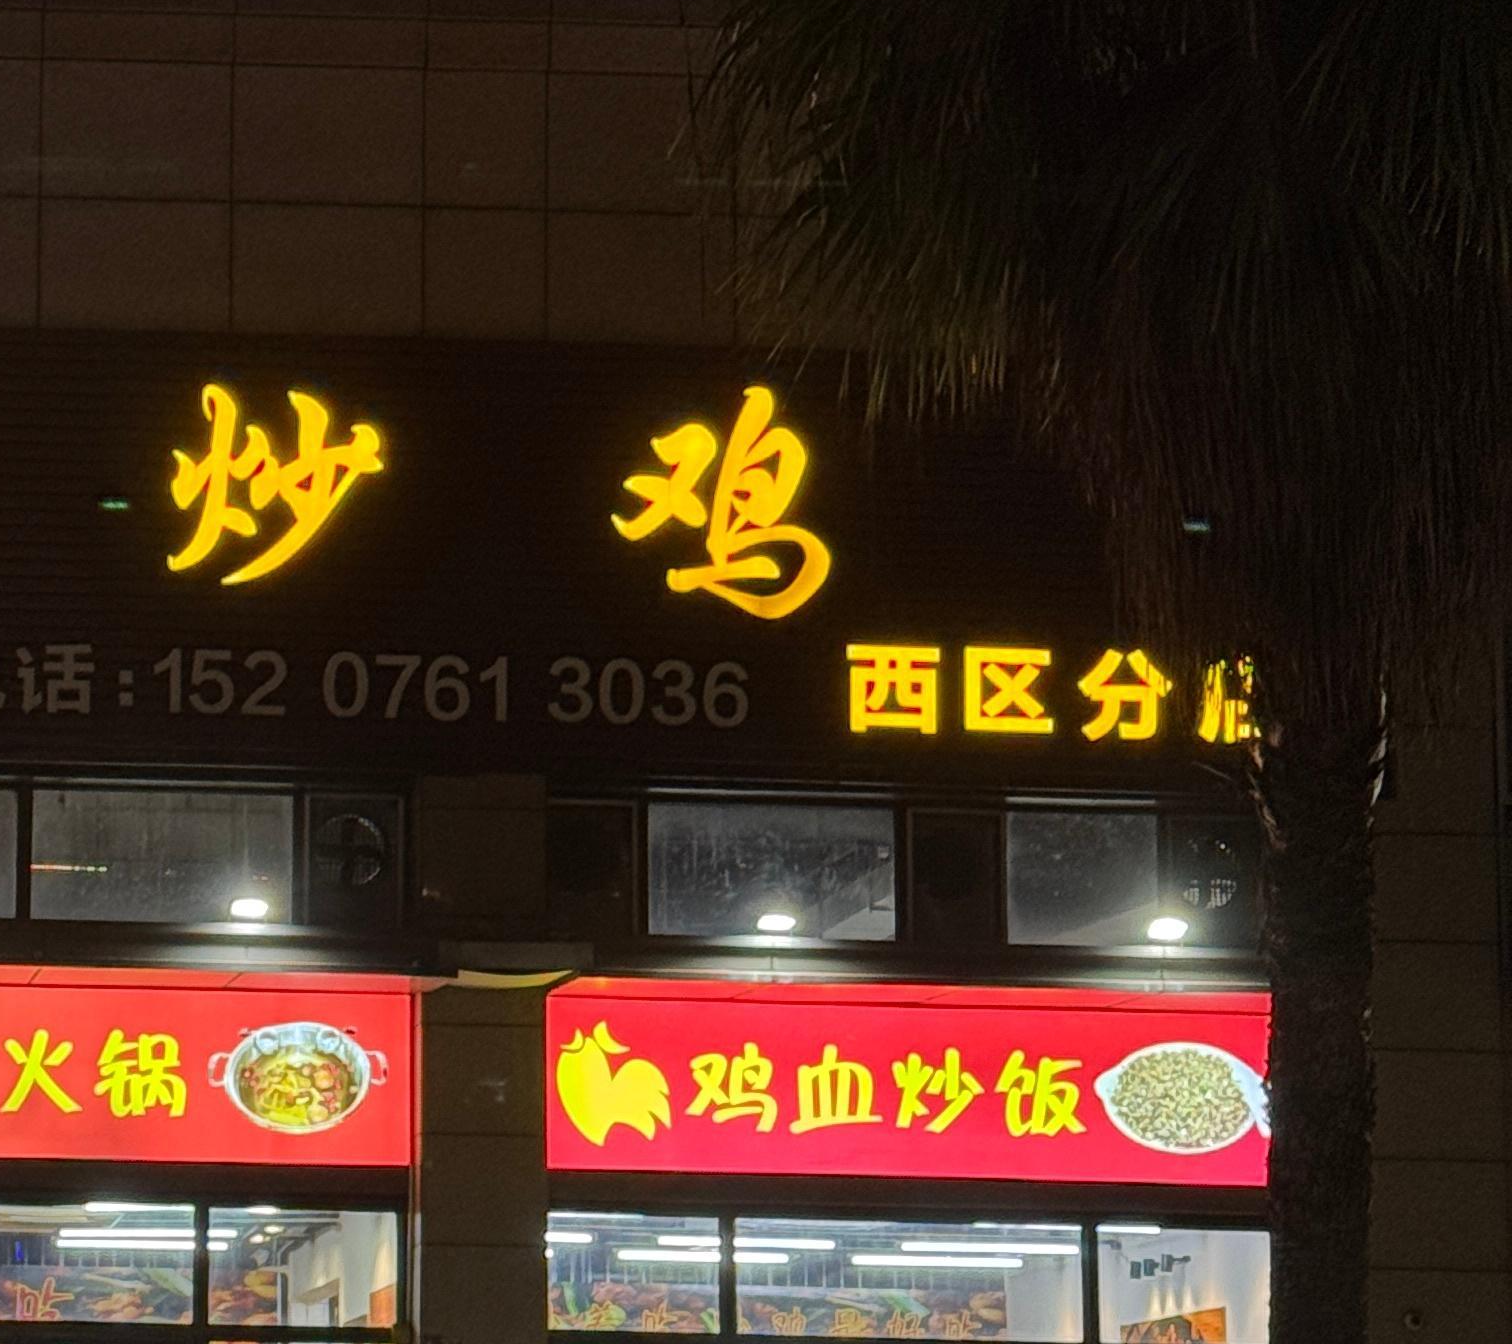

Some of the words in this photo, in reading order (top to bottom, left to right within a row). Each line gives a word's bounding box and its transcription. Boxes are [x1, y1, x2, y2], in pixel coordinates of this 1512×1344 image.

[322, 652, 509, 722] 0761
[549, 657, 750, 728] 3036
[686, 1041, 1088, 1138] 鸡血炒饭
